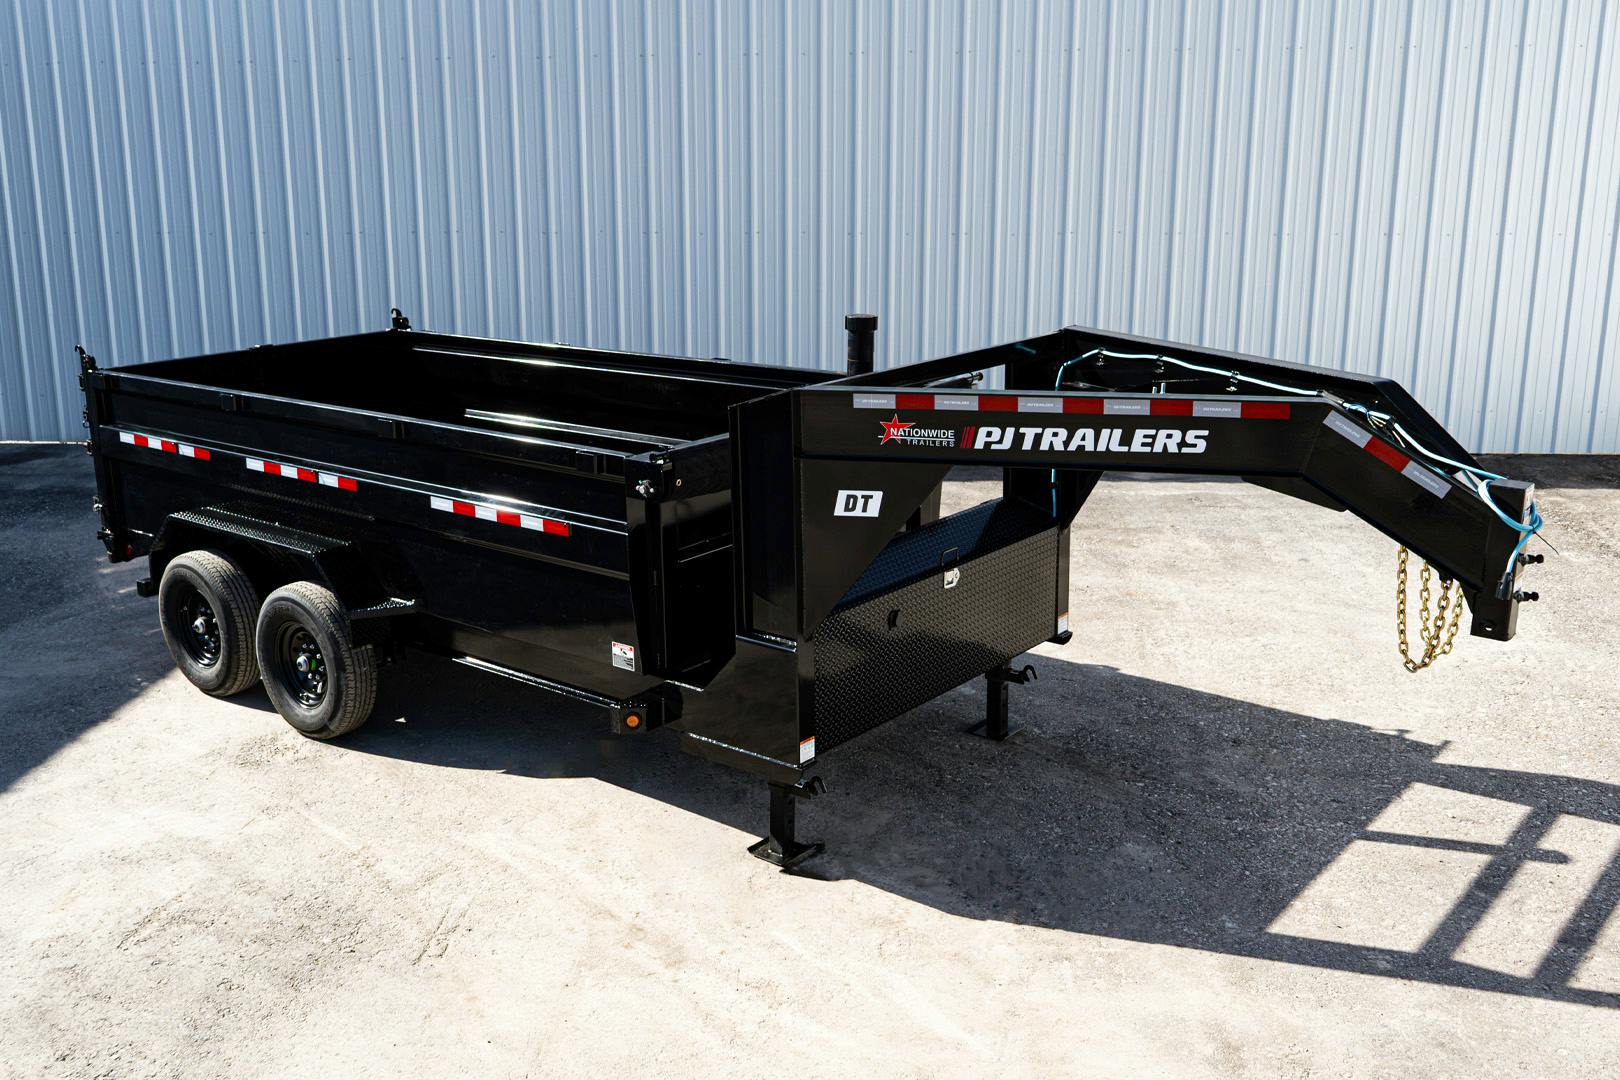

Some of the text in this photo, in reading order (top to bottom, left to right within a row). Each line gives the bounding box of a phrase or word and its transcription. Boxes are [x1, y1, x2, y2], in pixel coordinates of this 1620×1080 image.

[890, 427, 955, 439] NATIONWIDE
[974, 426, 1210, 454] PJ TRAILERS
[907, 439, 955, 447] TRAILERS
[843, 494, 874, 513] DT
